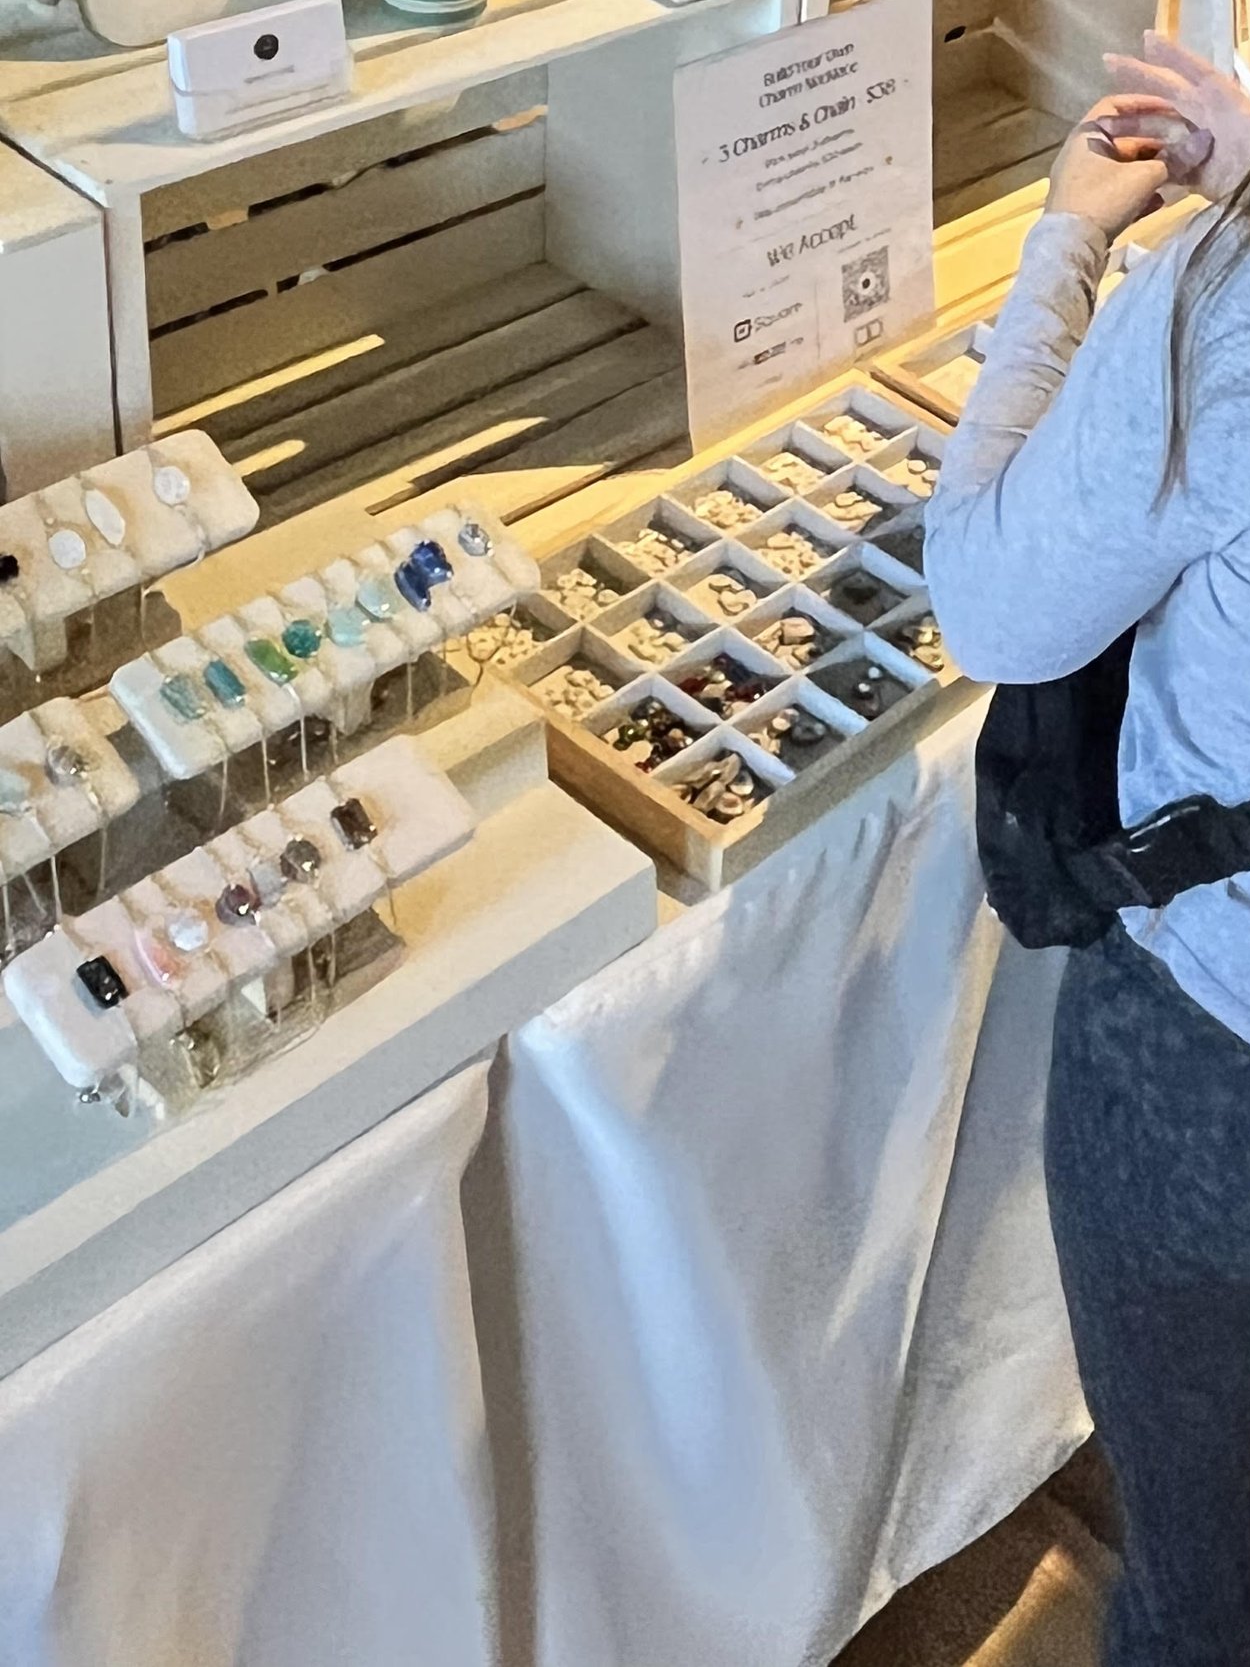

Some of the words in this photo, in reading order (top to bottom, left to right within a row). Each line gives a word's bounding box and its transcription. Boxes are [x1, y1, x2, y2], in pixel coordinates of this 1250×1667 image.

[733, 121, 795, 156] Charms
[814, 95, 856, 124] Chain
[767, 242, 794, 267] We
[799, 214, 858, 254] Accept
